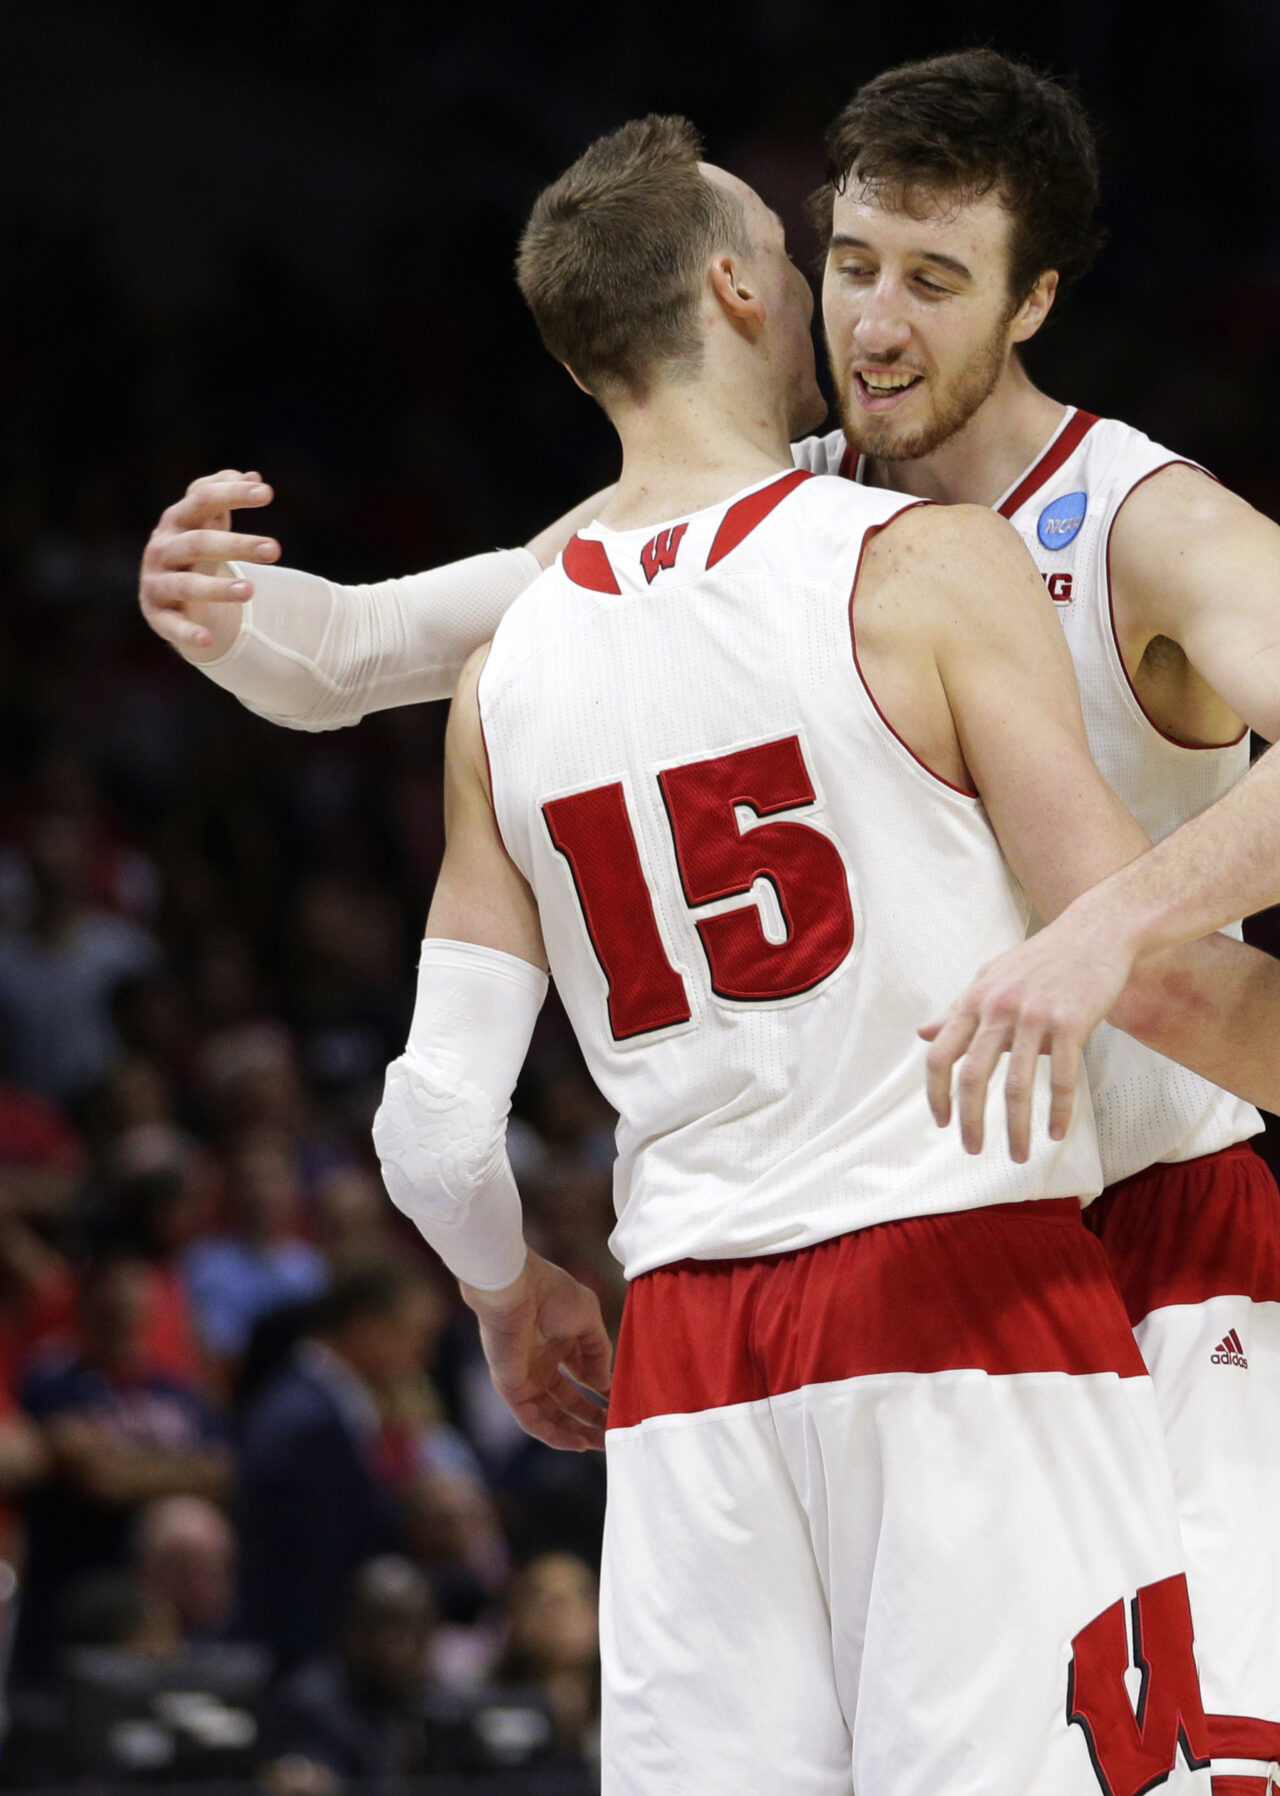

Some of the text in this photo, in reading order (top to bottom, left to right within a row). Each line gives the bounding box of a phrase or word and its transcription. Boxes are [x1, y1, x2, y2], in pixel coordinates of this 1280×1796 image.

[1045, 515, 1082, 534] NC
[1041, 573, 1073, 602] G
[540, 735, 854, 1041] 15
[1210, 1351, 1248, 1370] adidas
